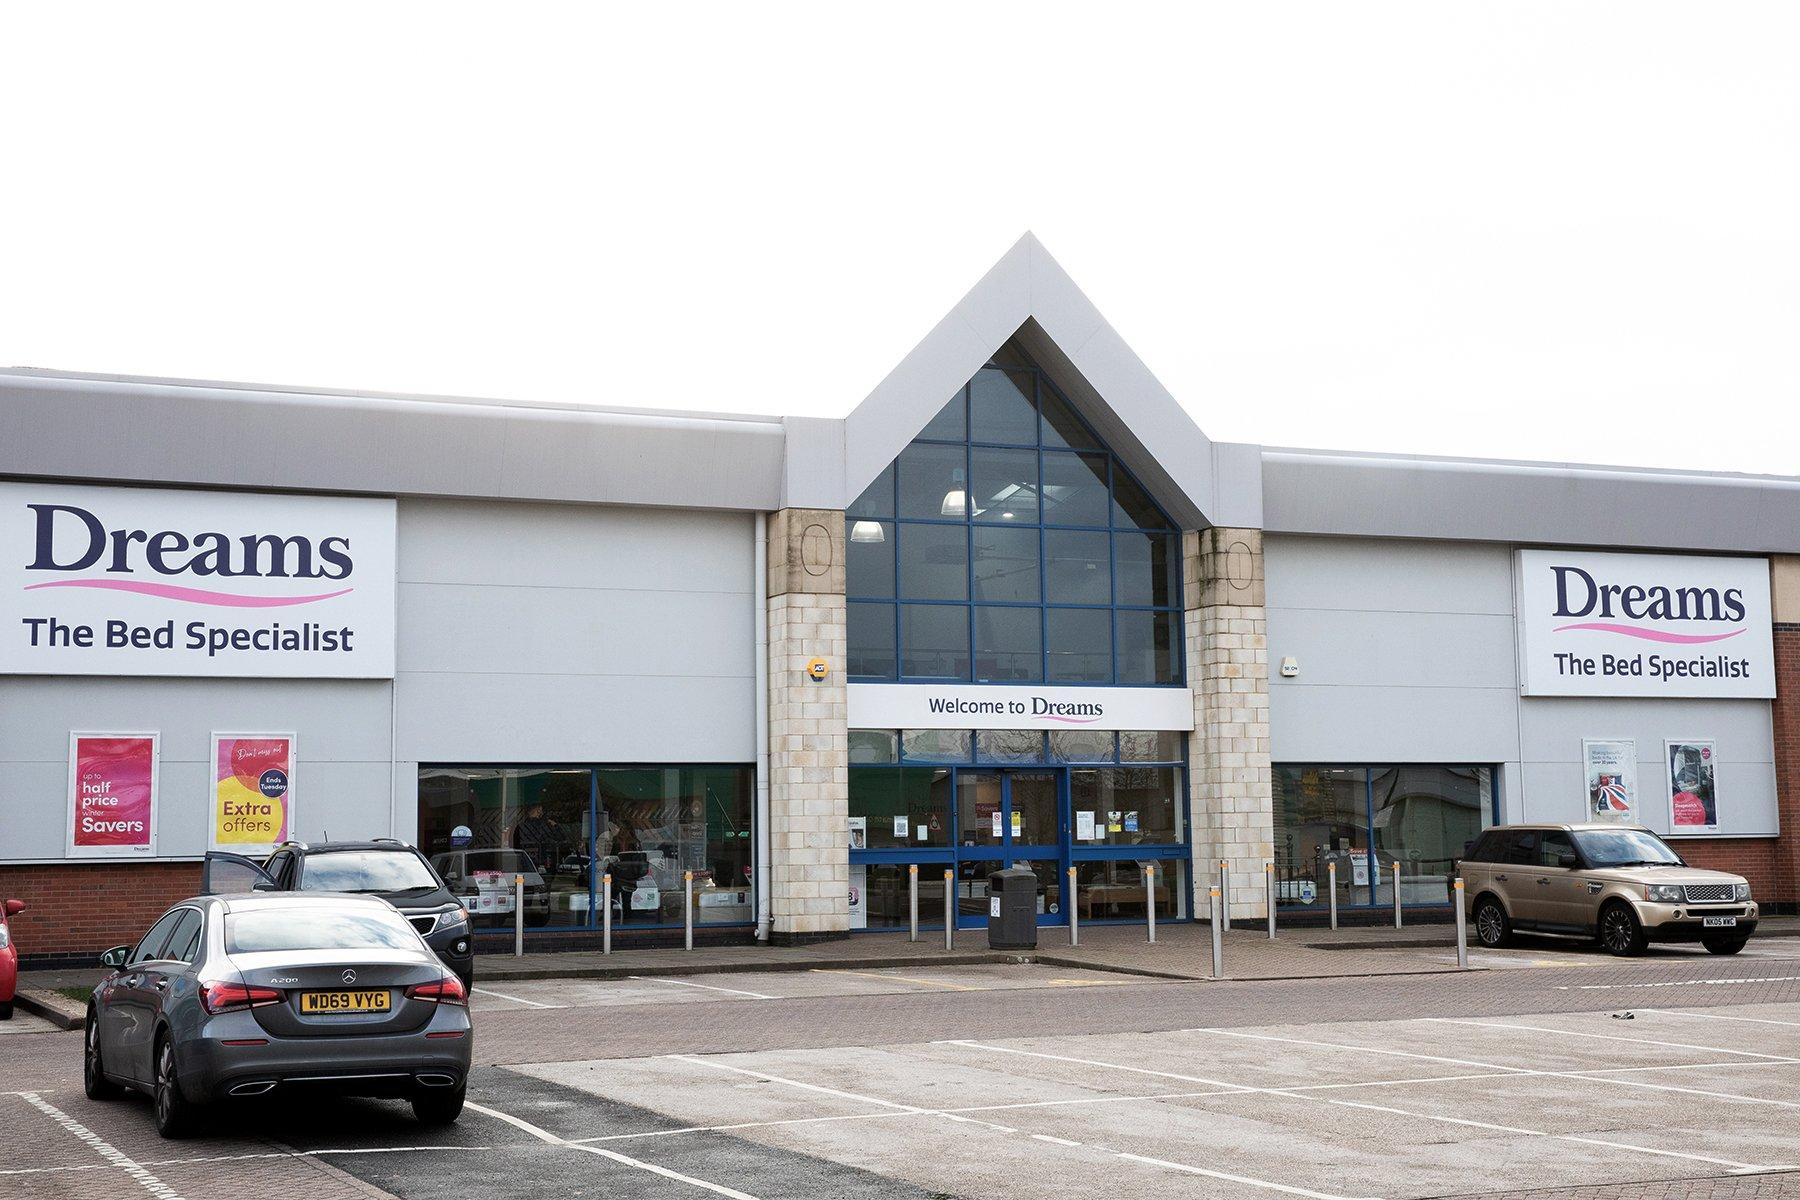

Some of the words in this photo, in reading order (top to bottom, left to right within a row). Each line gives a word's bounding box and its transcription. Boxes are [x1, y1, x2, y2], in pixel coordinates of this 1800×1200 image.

[25, 503, 354, 580] Dreams
[1550, 565, 1746, 622] Dreams
[22, 617, 94, 648] The
[106, 619, 174, 650] Bed
[185, 621, 354, 657] Specialist
[1554, 653, 1596, 676] The
[1602, 654, 1643, 676] Bed
[1649, 655, 1750, 682] Specialist
[929, 698, 1004, 714] Welcome
[1008, 699, 1025, 714] to
[1031, 697, 1103, 716] Dreams
[83, 781, 111, 794] half
[82, 794, 118, 809] price
[223, 801, 271, 815] Extra
[82, 817, 143, 832] Savers
[223, 817, 271, 832] offers
[309, 992, 350, 1009] WD69
[354, 992, 384, 1008] VYG
